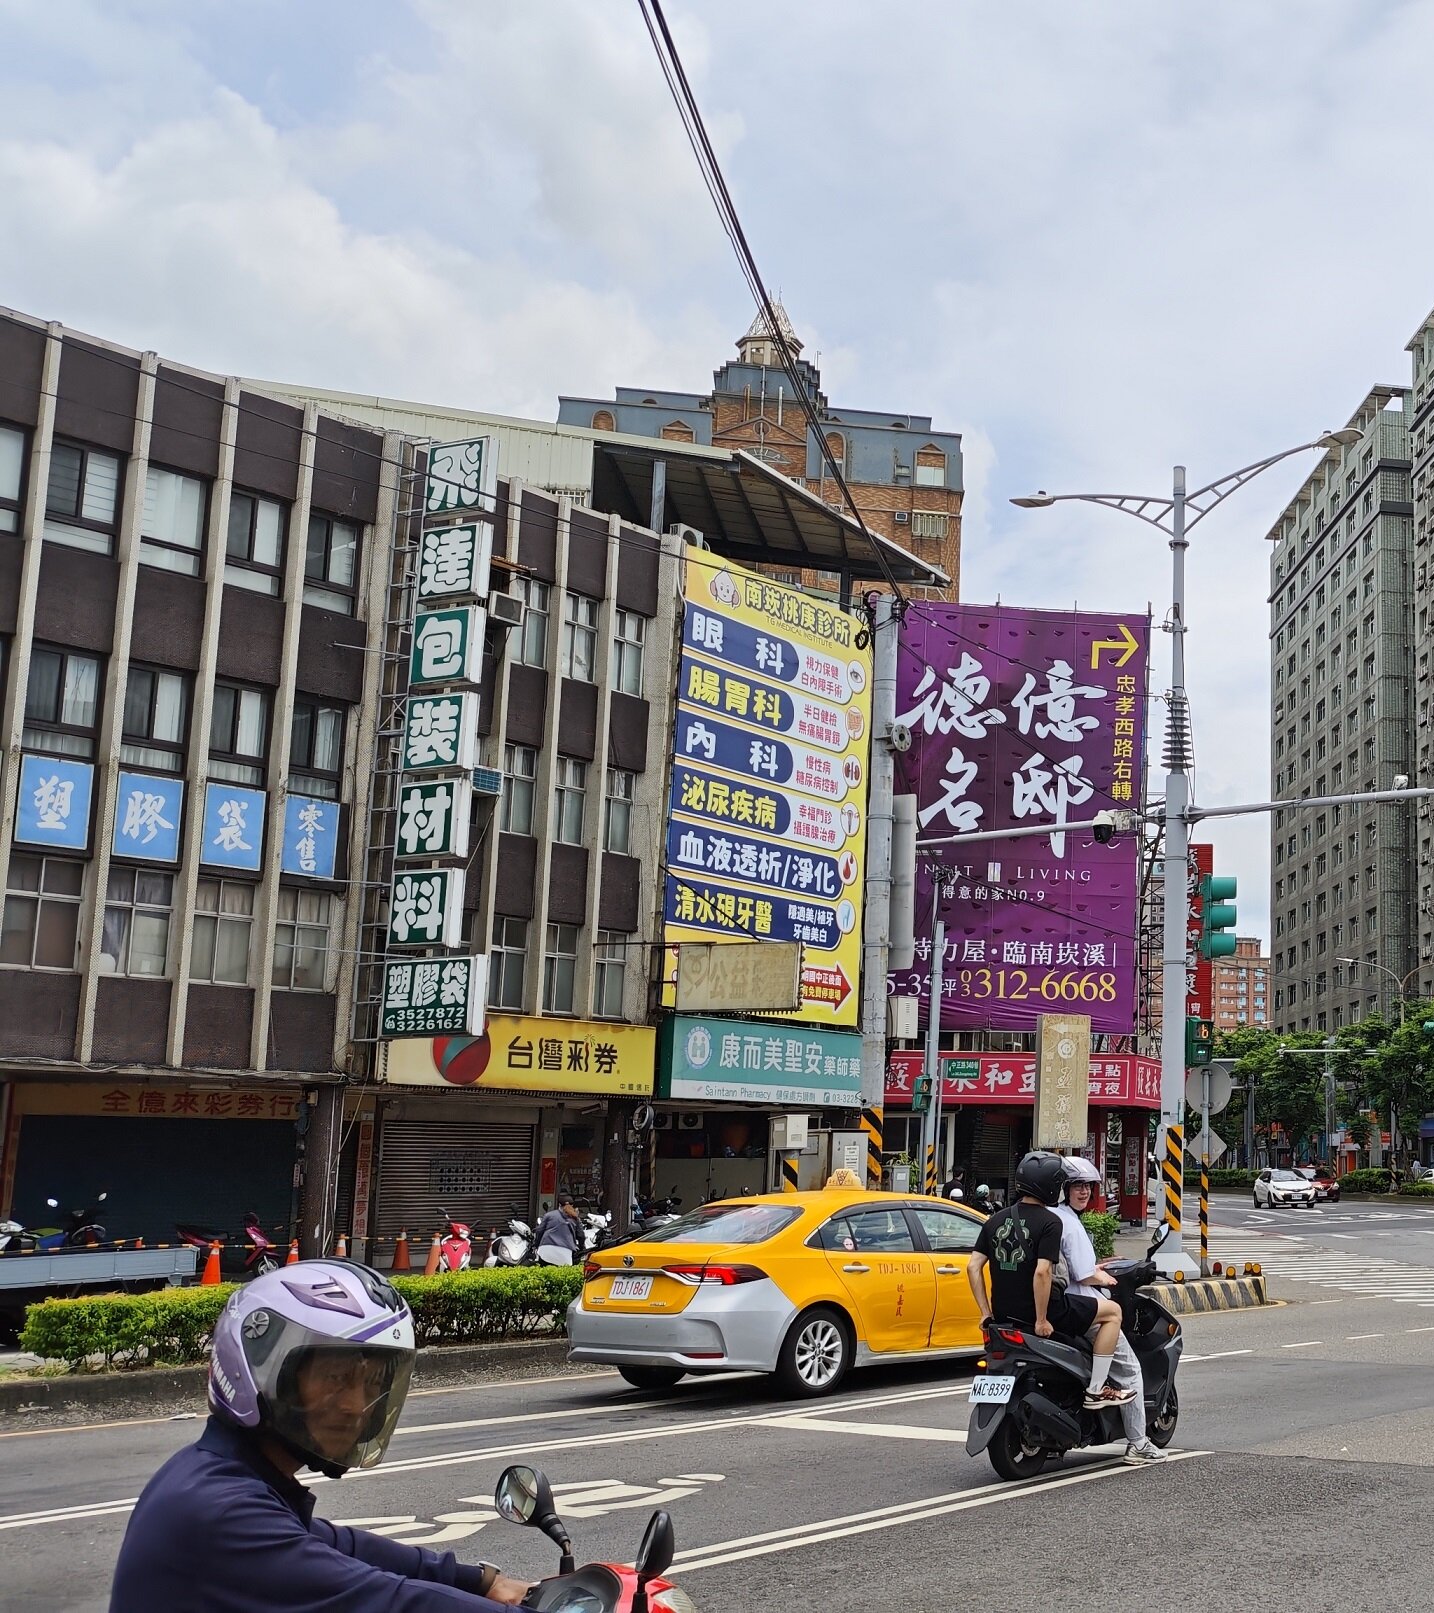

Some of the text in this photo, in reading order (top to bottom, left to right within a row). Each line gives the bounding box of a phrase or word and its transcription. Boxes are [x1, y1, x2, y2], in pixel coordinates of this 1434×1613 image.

[692, 611, 785, 675] 眼科
[805, 655, 840, 684] 視力保健
[687, 665, 782, 727] 腸胃科
[800, 671, 843, 700] 白內障手術
[685, 721, 779, 778] 內科
[1111, 674, 1136, 801] 忠孝西路右轉
[805, 755, 832, 776] 慢性病
[681, 773, 777, 830] 泌尿疾病
[676, 830, 836, 894] 血液透析/淨化
[1017, 865, 1092, 882] LIVING
[386, 960, 469, 1009] 塑膠袋
[973, 969, 1117, 1003] 312-6668
[396, 1006, 465, 1021] 3527872
[396, 1017, 463, 1031] 3226162
[823, 1055, 861, 1078] 藥師藥
[740, 1086, 771, 1100] Pharmacy
[970, 1381, 1012, 1398] NAC-8399
